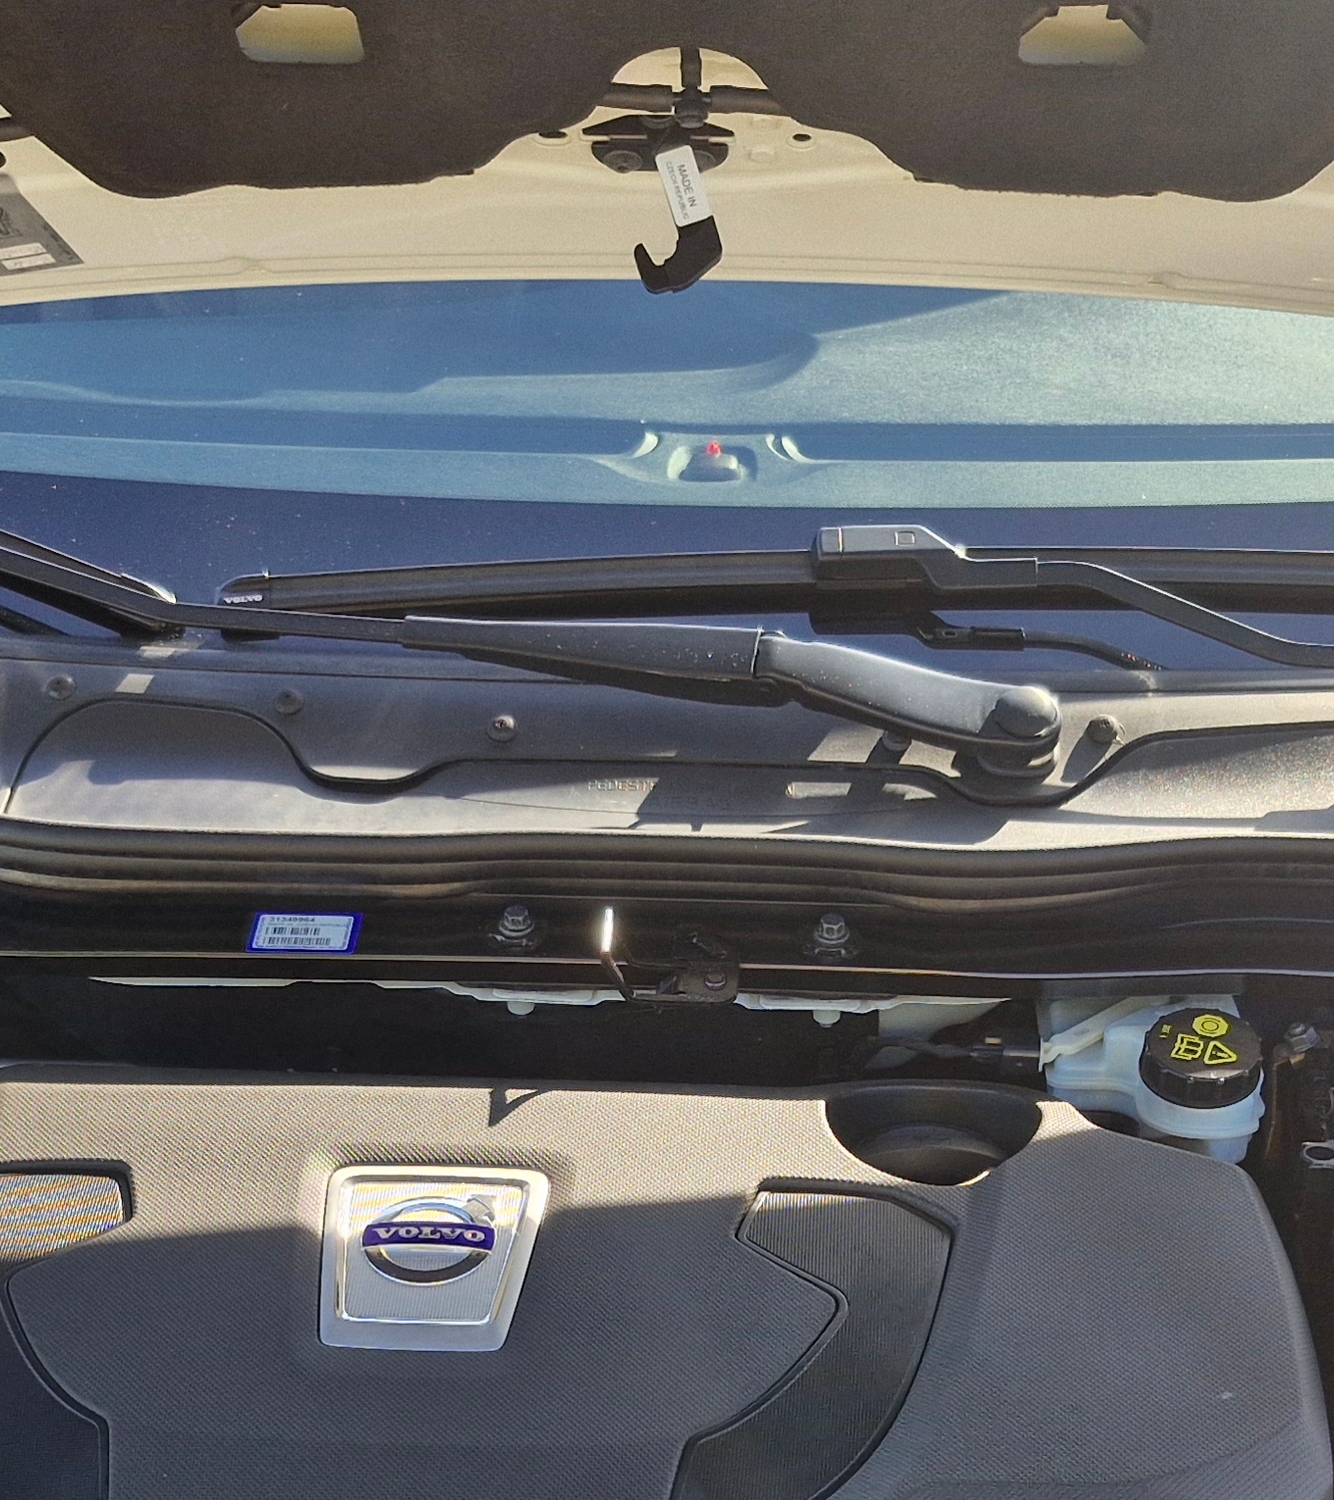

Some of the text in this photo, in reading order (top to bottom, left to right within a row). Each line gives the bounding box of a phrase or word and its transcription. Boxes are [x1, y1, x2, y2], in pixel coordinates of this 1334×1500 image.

[677, 163, 697, 208] MADE IN
[672, 184, 689, 220] REPUBLIC
[223, 594, 263, 604] VOLVO
[373, 1227, 485, 1242] VOLVO
